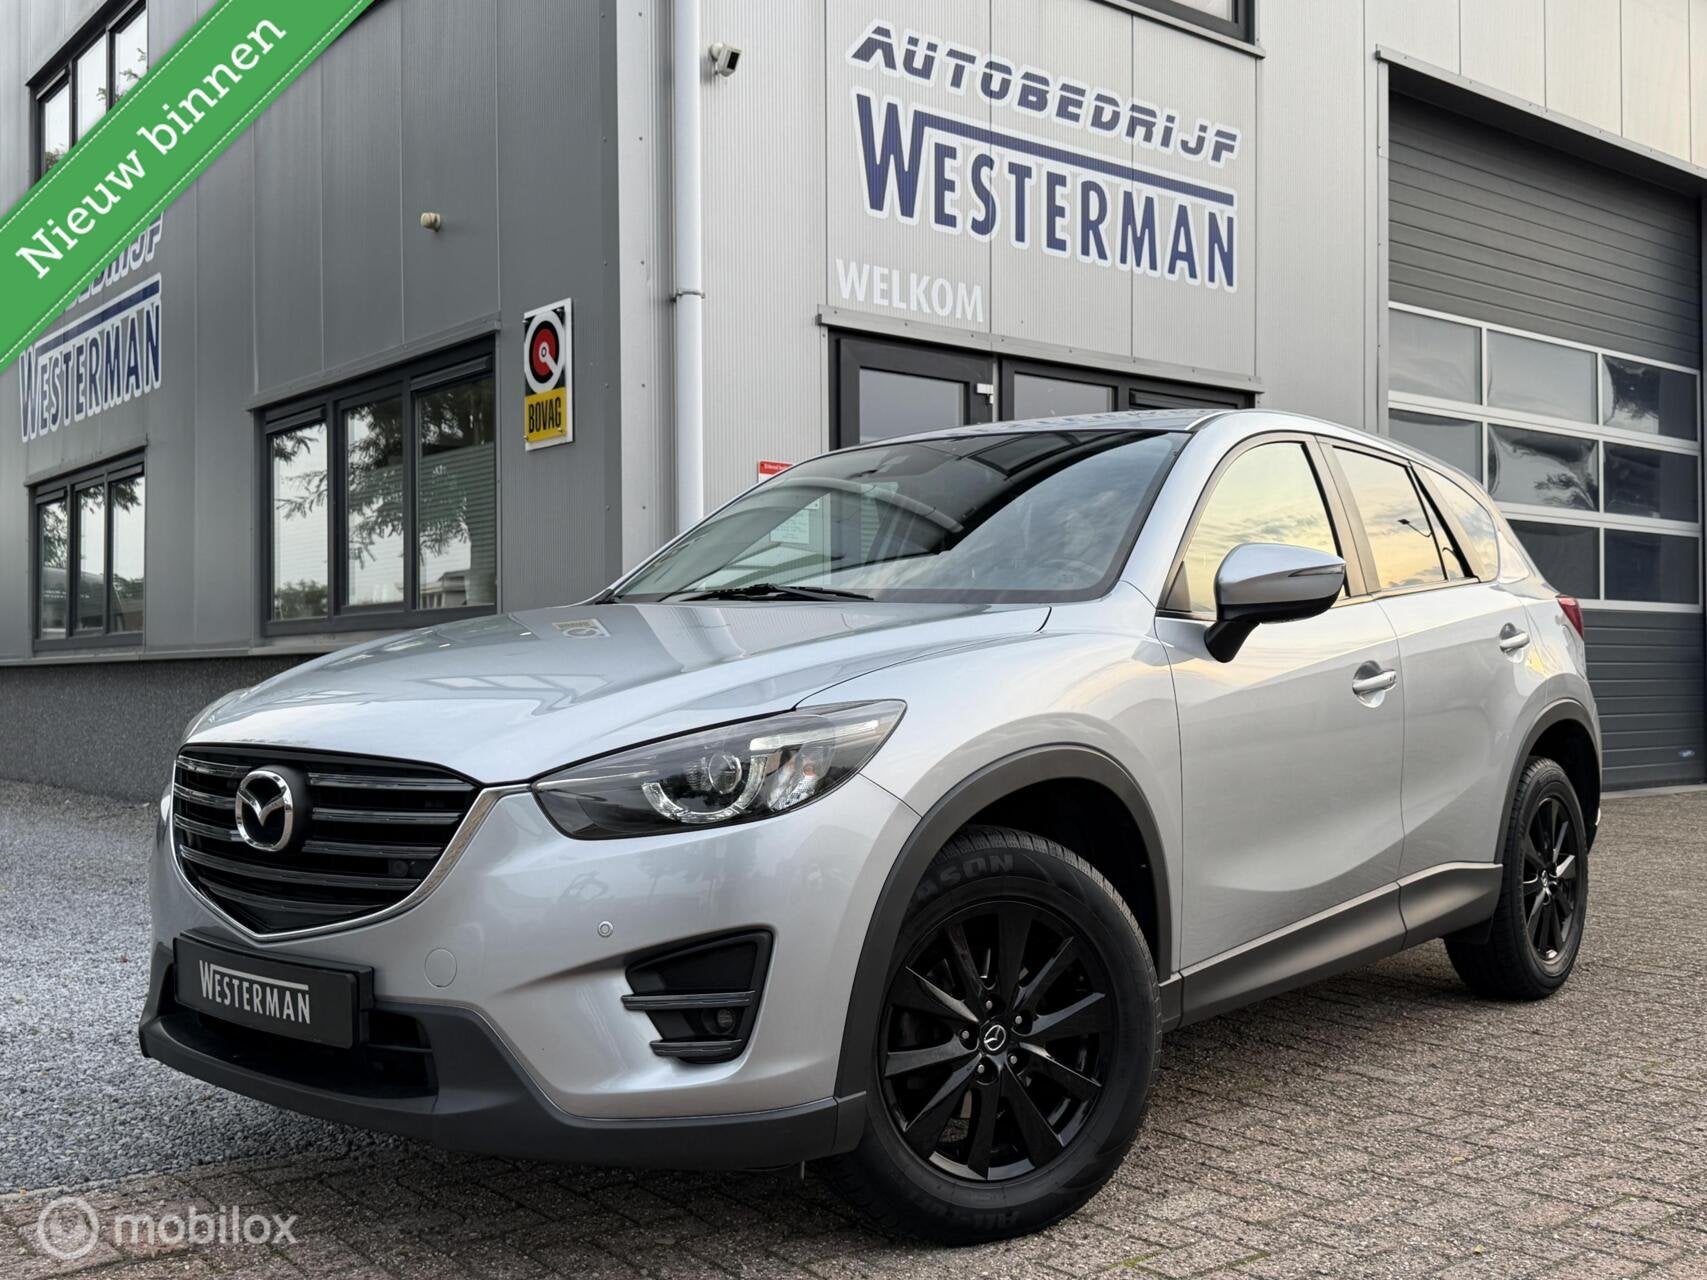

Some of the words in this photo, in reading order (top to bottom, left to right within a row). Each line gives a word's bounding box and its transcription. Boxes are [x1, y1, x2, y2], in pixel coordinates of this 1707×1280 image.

[854, 90, 1236, 290] WESTERMAN
[836, 258, 984, 322] WELKOM
[20, 278, 161, 440] WESTERMAN
[528, 397, 562, 433] BOVAG
[199, 960, 311, 1024] WESTERMAN
